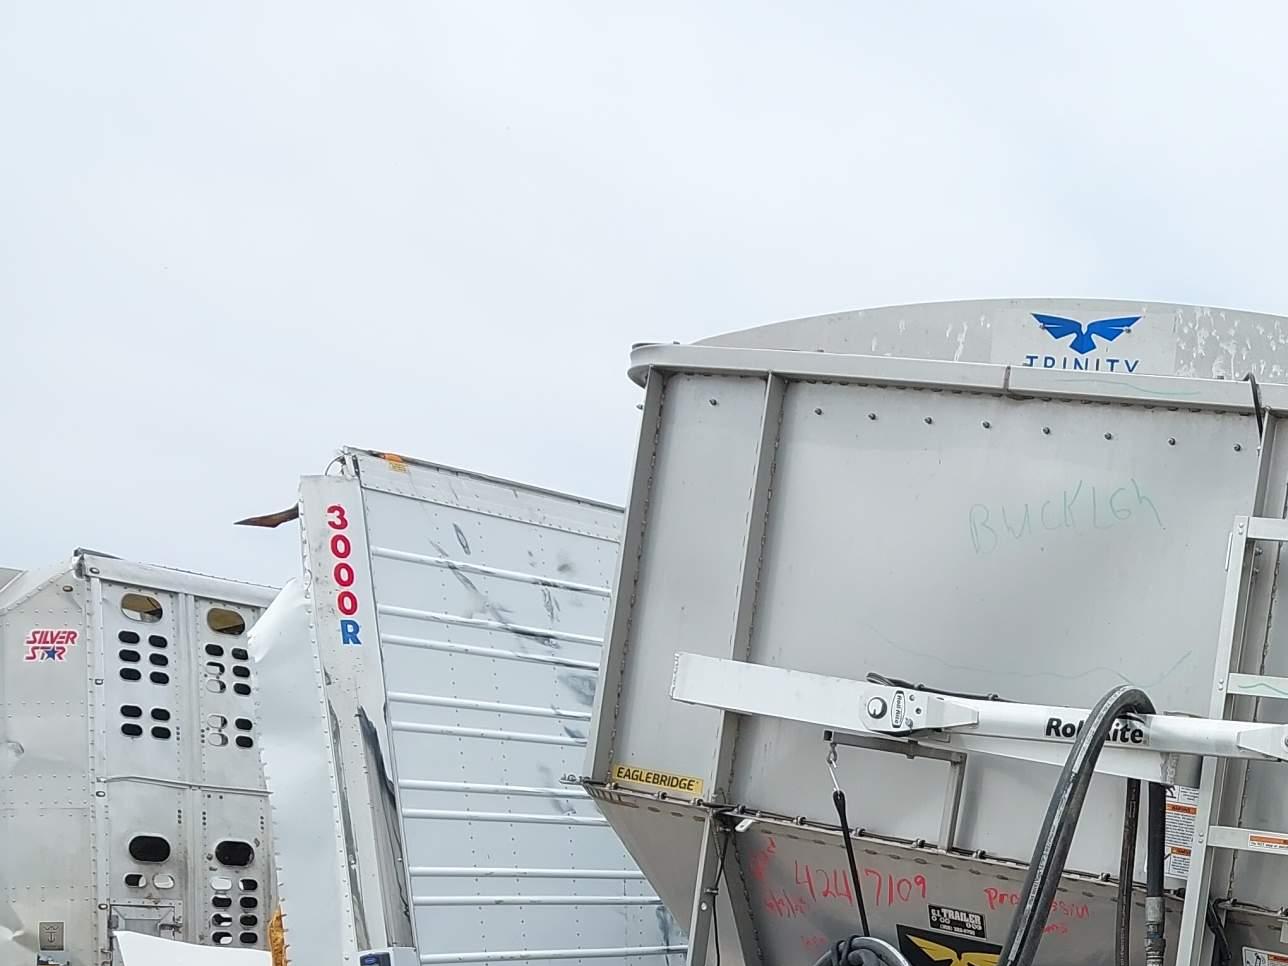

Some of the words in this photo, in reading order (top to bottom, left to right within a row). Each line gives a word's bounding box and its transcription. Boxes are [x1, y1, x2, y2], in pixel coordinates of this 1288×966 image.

[26, 630, 78, 645] SILVER
[617, 767, 696, 791] EAGLEBRIDGE
[941, 908, 981, 925] TRAILER
